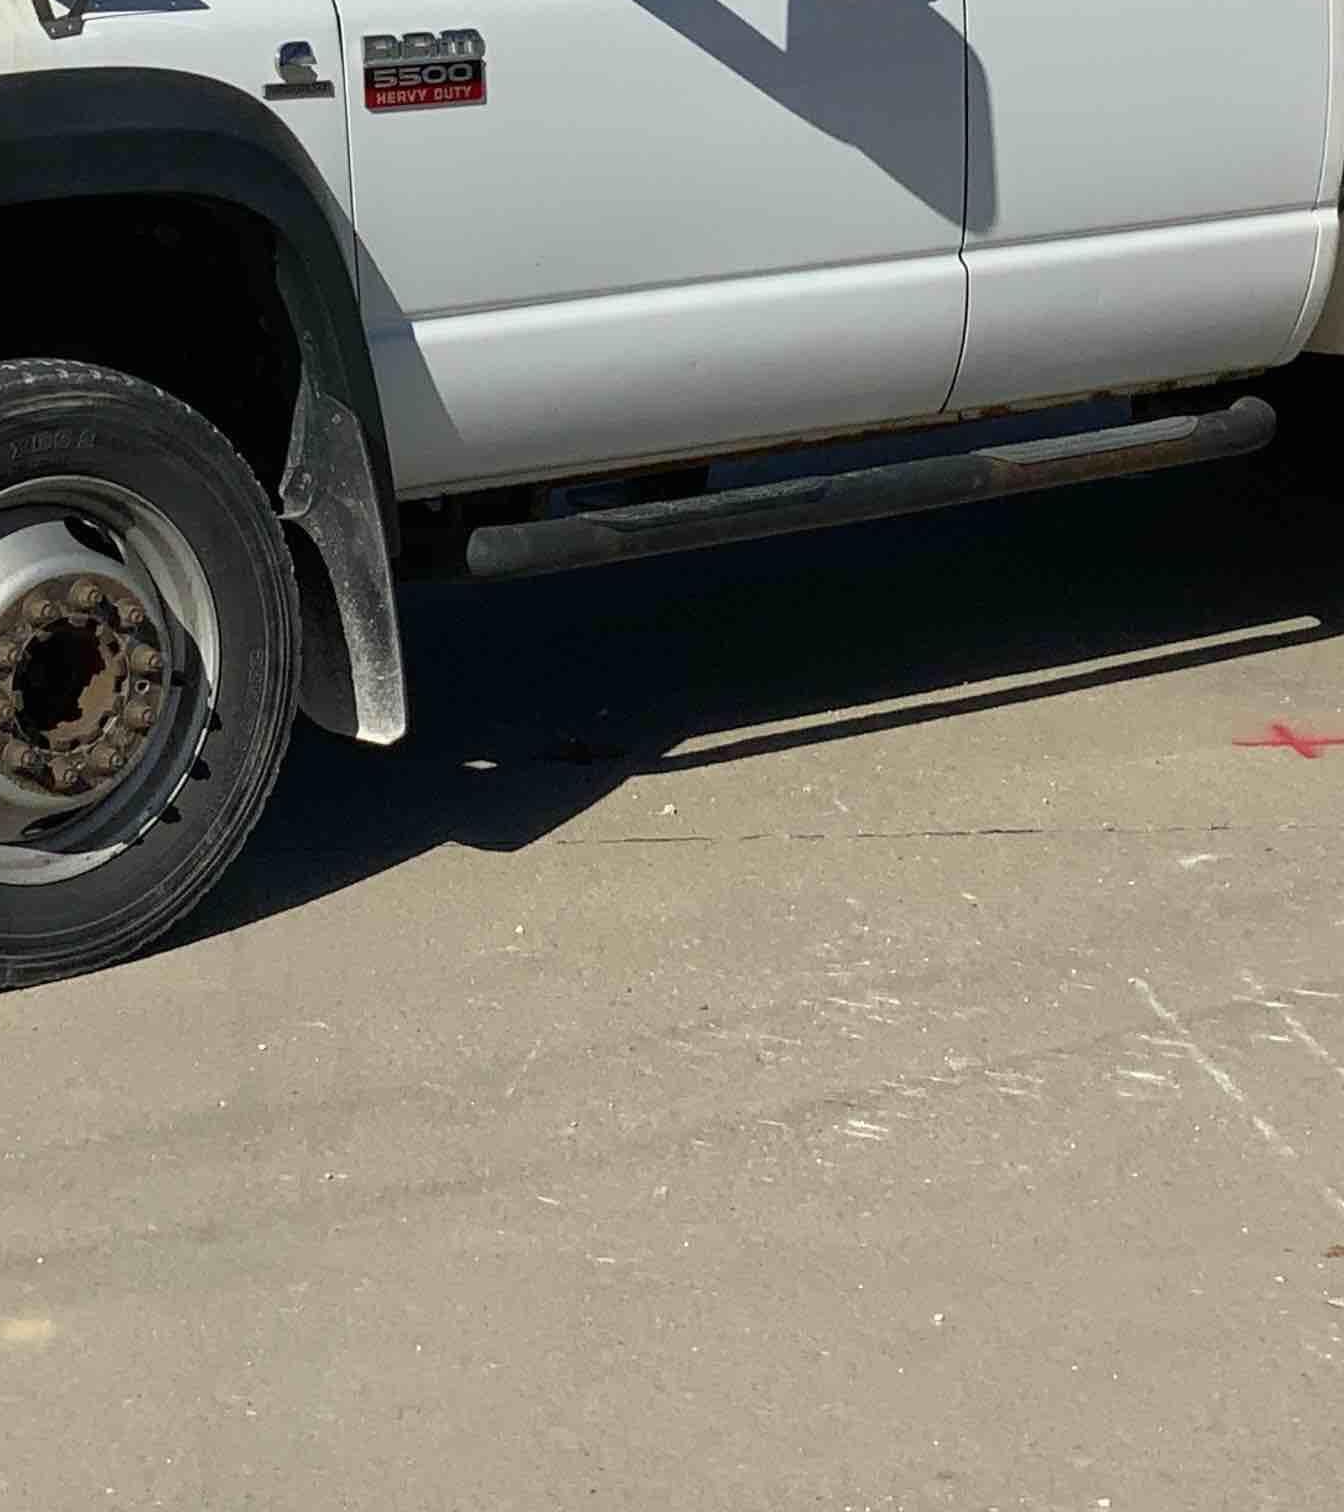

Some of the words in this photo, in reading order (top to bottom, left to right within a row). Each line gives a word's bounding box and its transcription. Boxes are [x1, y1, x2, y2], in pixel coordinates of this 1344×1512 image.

[374, 63, 473, 88] 5500
[375, 89, 427, 105] HEAVY
[433, 86, 472, 101] DUTY
